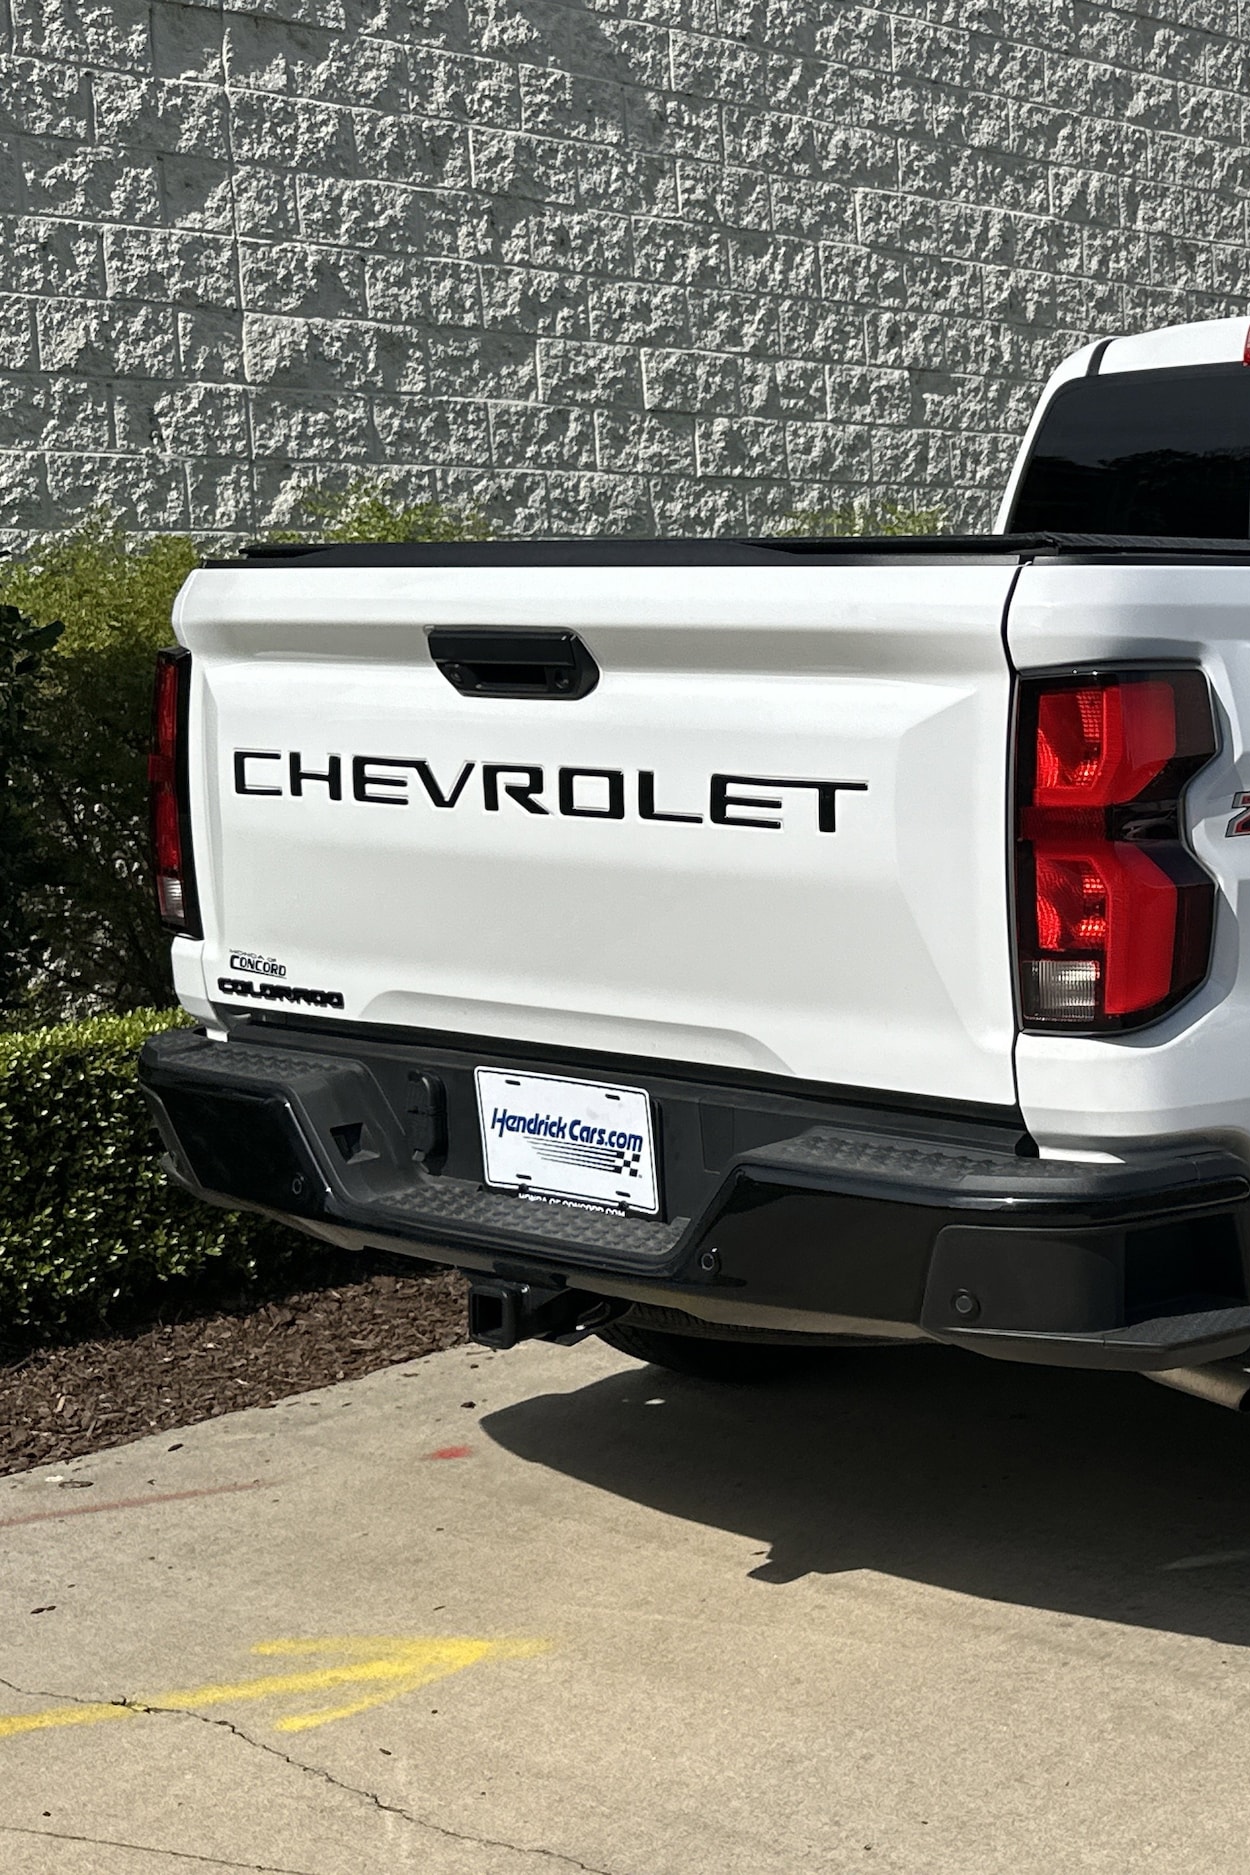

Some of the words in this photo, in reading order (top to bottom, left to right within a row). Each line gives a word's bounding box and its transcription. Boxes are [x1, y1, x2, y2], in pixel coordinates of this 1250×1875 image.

[233, 748, 868, 833] CHEVROLET
[229, 954, 288, 978] CONCORD
[217, 977, 345, 1010] COLORADO
